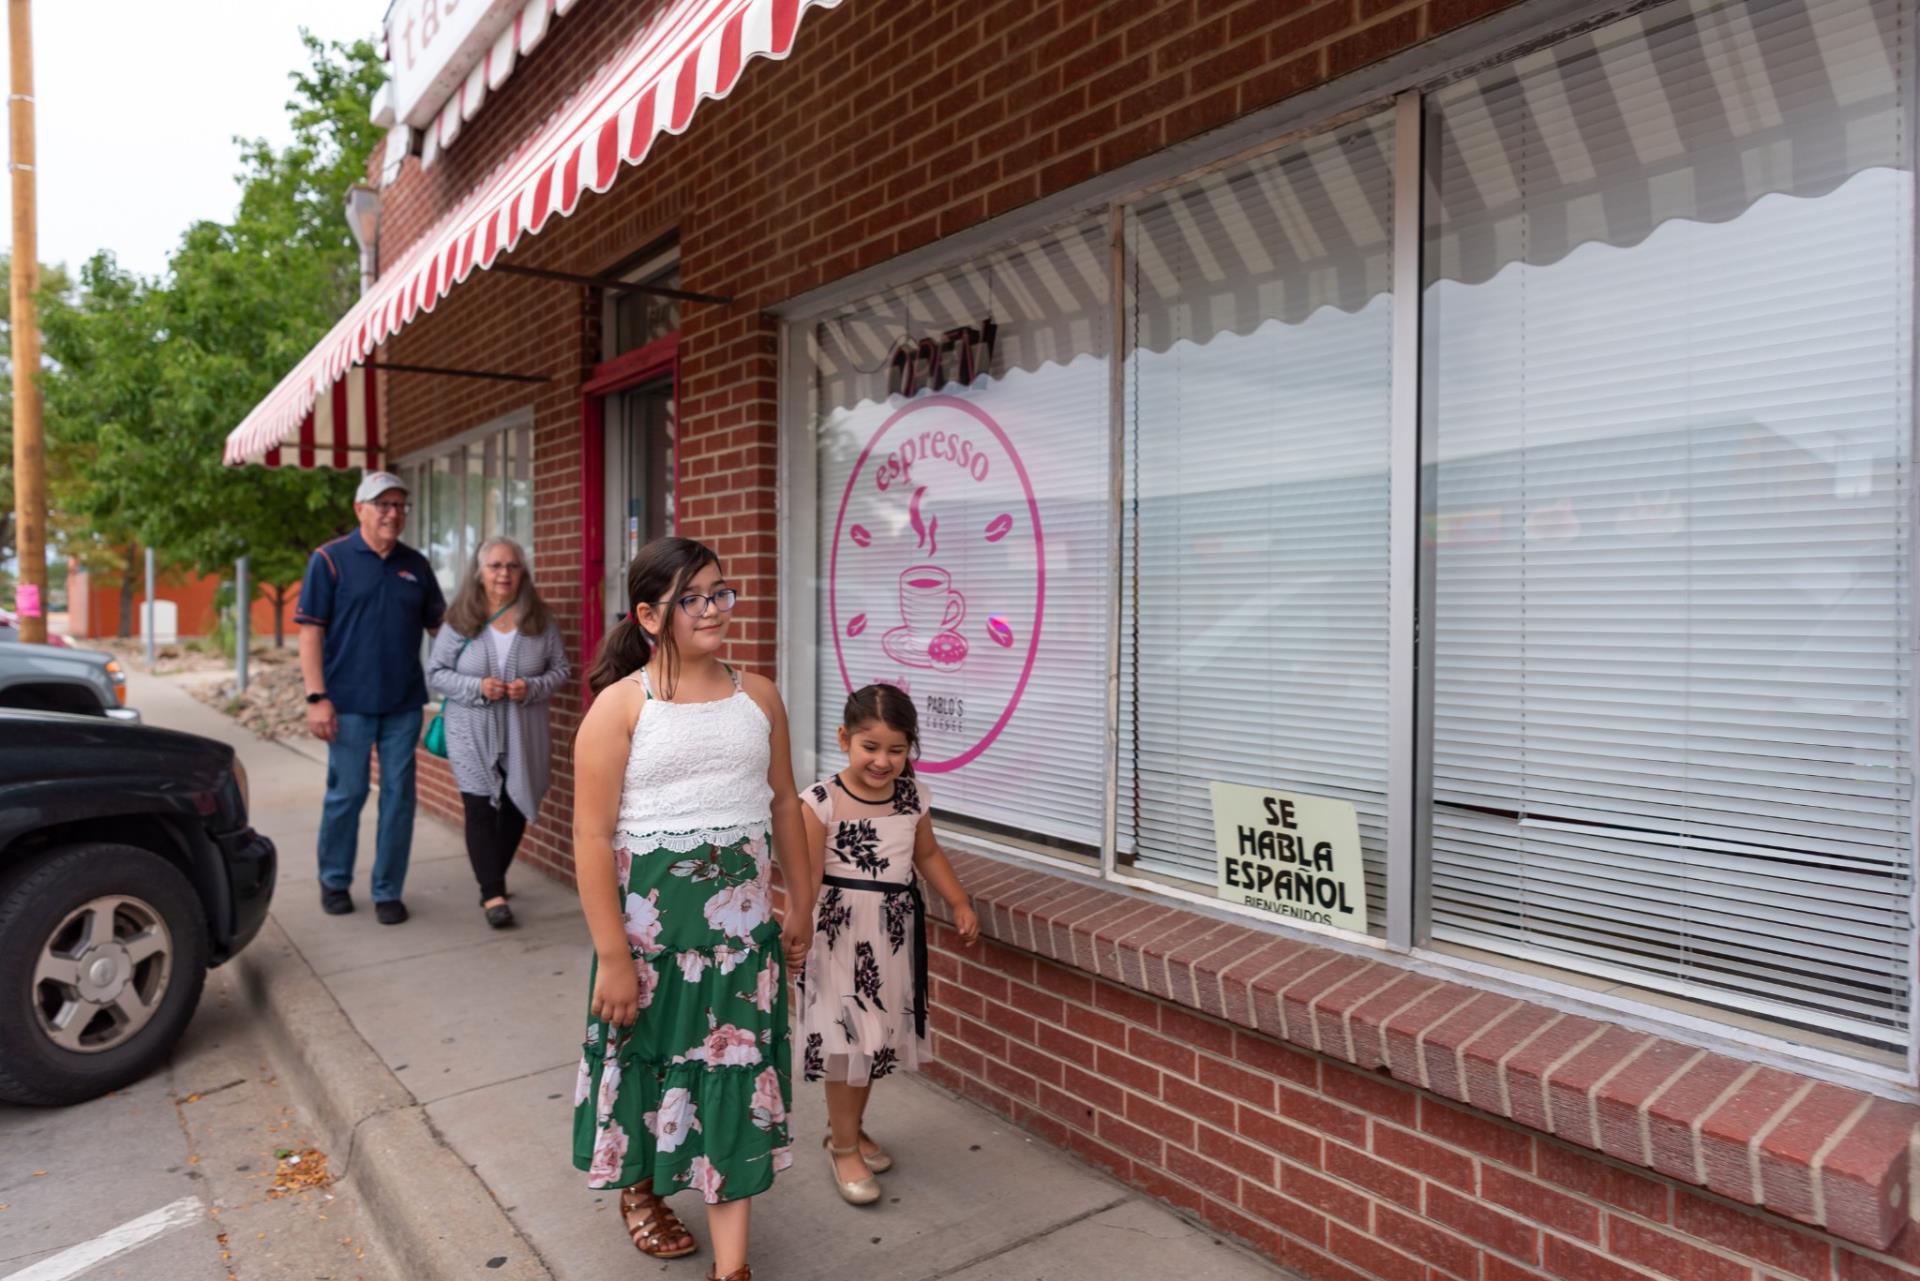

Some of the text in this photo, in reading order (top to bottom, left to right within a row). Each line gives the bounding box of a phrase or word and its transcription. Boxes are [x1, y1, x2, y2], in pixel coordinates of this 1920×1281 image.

[876, 431, 989, 492] espresso
[926, 695, 964, 717] PABLO'S
[1263, 796, 1298, 830] SE
[1237, 824, 1334, 872] HABLA
[1225, 857, 1354, 915] ESPAÑOL
[1244, 895, 1333, 926] BIENVENIDOS
